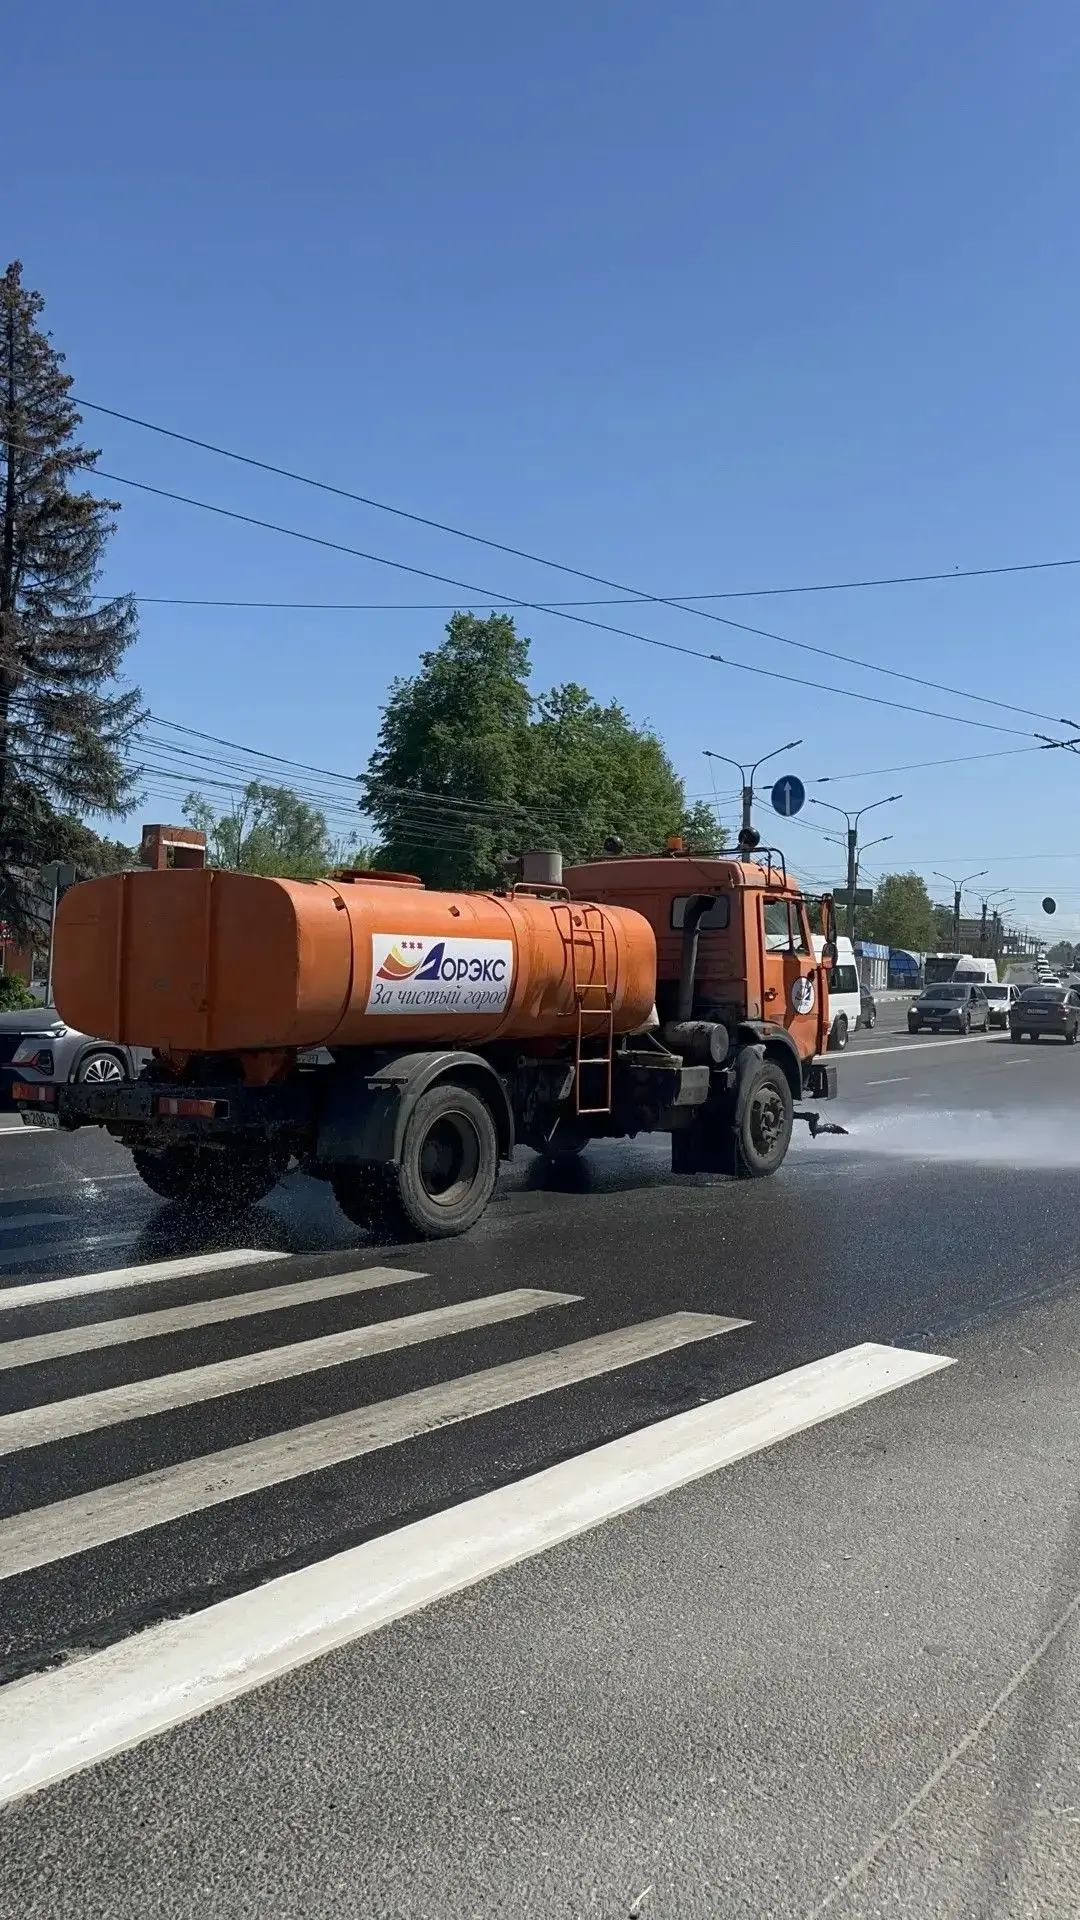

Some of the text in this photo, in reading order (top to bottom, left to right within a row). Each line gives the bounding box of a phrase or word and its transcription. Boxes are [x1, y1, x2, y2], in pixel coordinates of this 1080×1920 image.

[371, 983, 508, 1009] За чистый город
